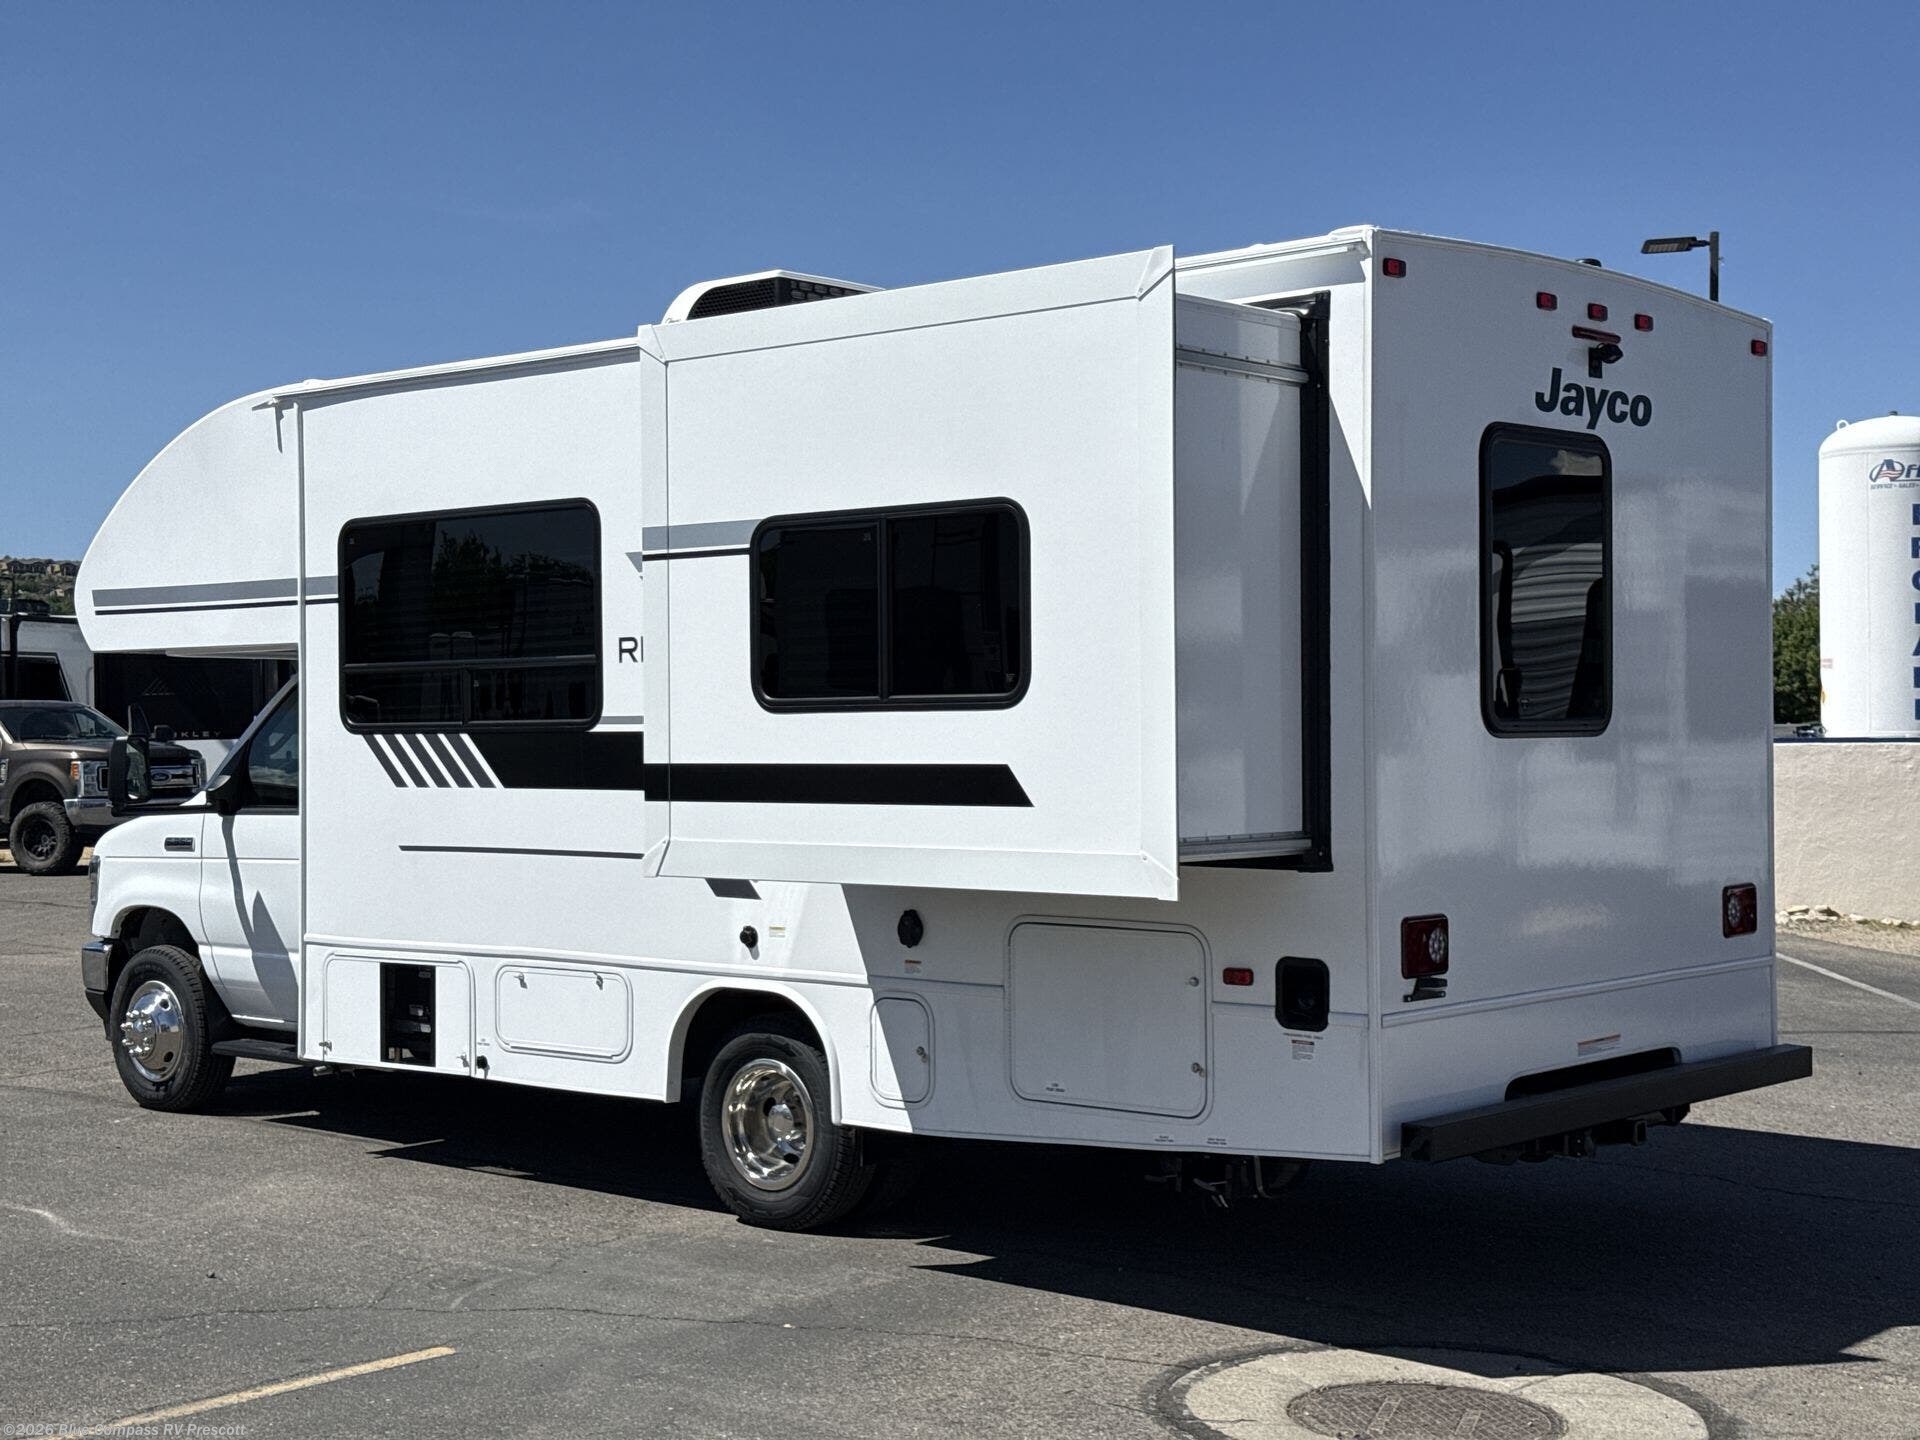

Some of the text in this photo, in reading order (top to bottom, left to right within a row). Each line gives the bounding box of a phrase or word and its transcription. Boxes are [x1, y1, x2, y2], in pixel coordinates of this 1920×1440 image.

[1535, 367, 1652, 429] Jayco
[618, 635, 644, 664] R
[173, 730, 222, 738] KLEY
